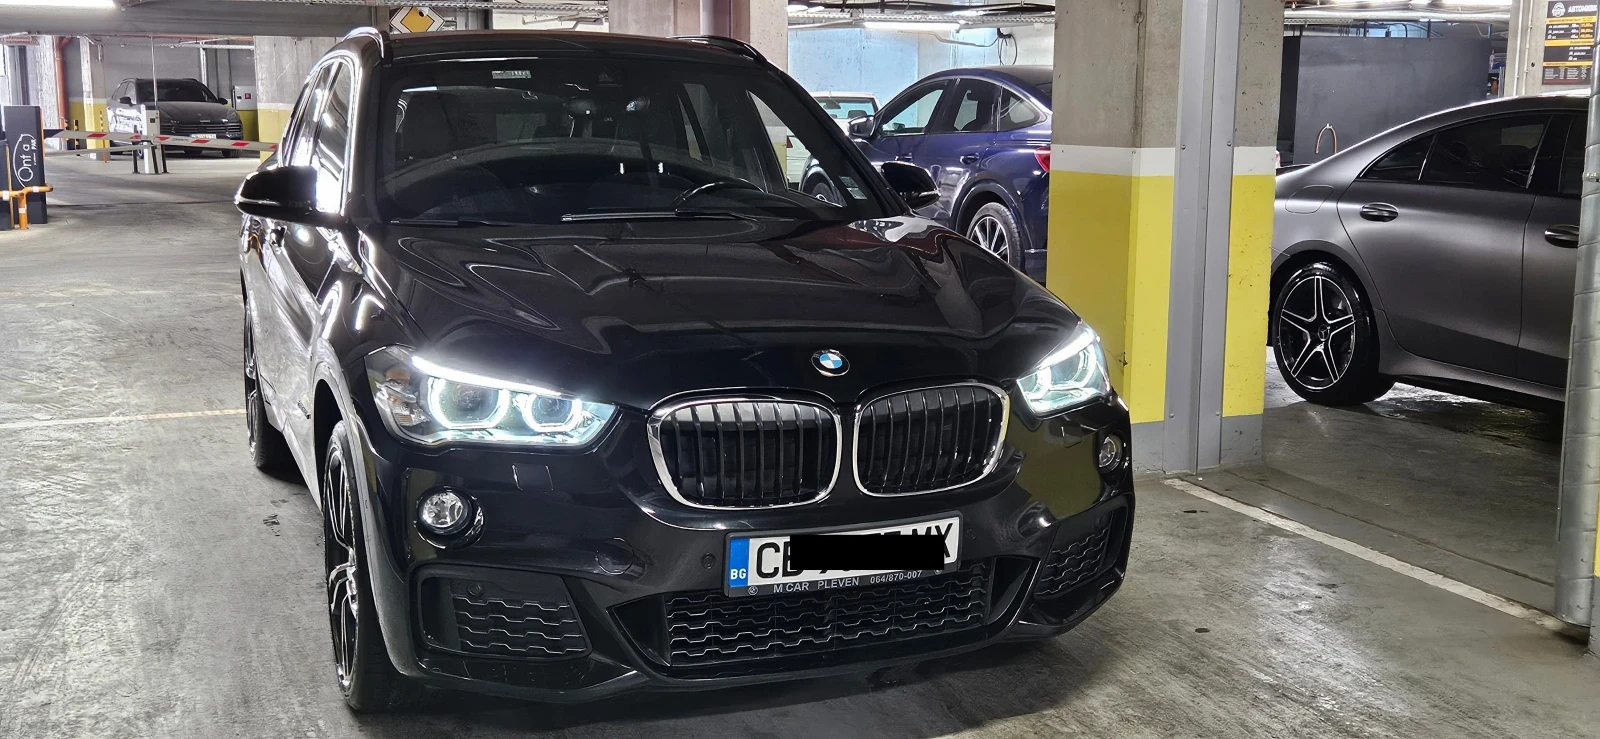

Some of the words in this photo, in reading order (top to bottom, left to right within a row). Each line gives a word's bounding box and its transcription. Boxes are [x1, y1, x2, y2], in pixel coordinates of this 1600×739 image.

[730, 568, 747, 580] BG
[773, 584, 783, 593] M
[785, 581, 809, 592] CAR
[817, 577, 860, 590] PLEVEN
[870, 570, 923, 584] 064/870-007
